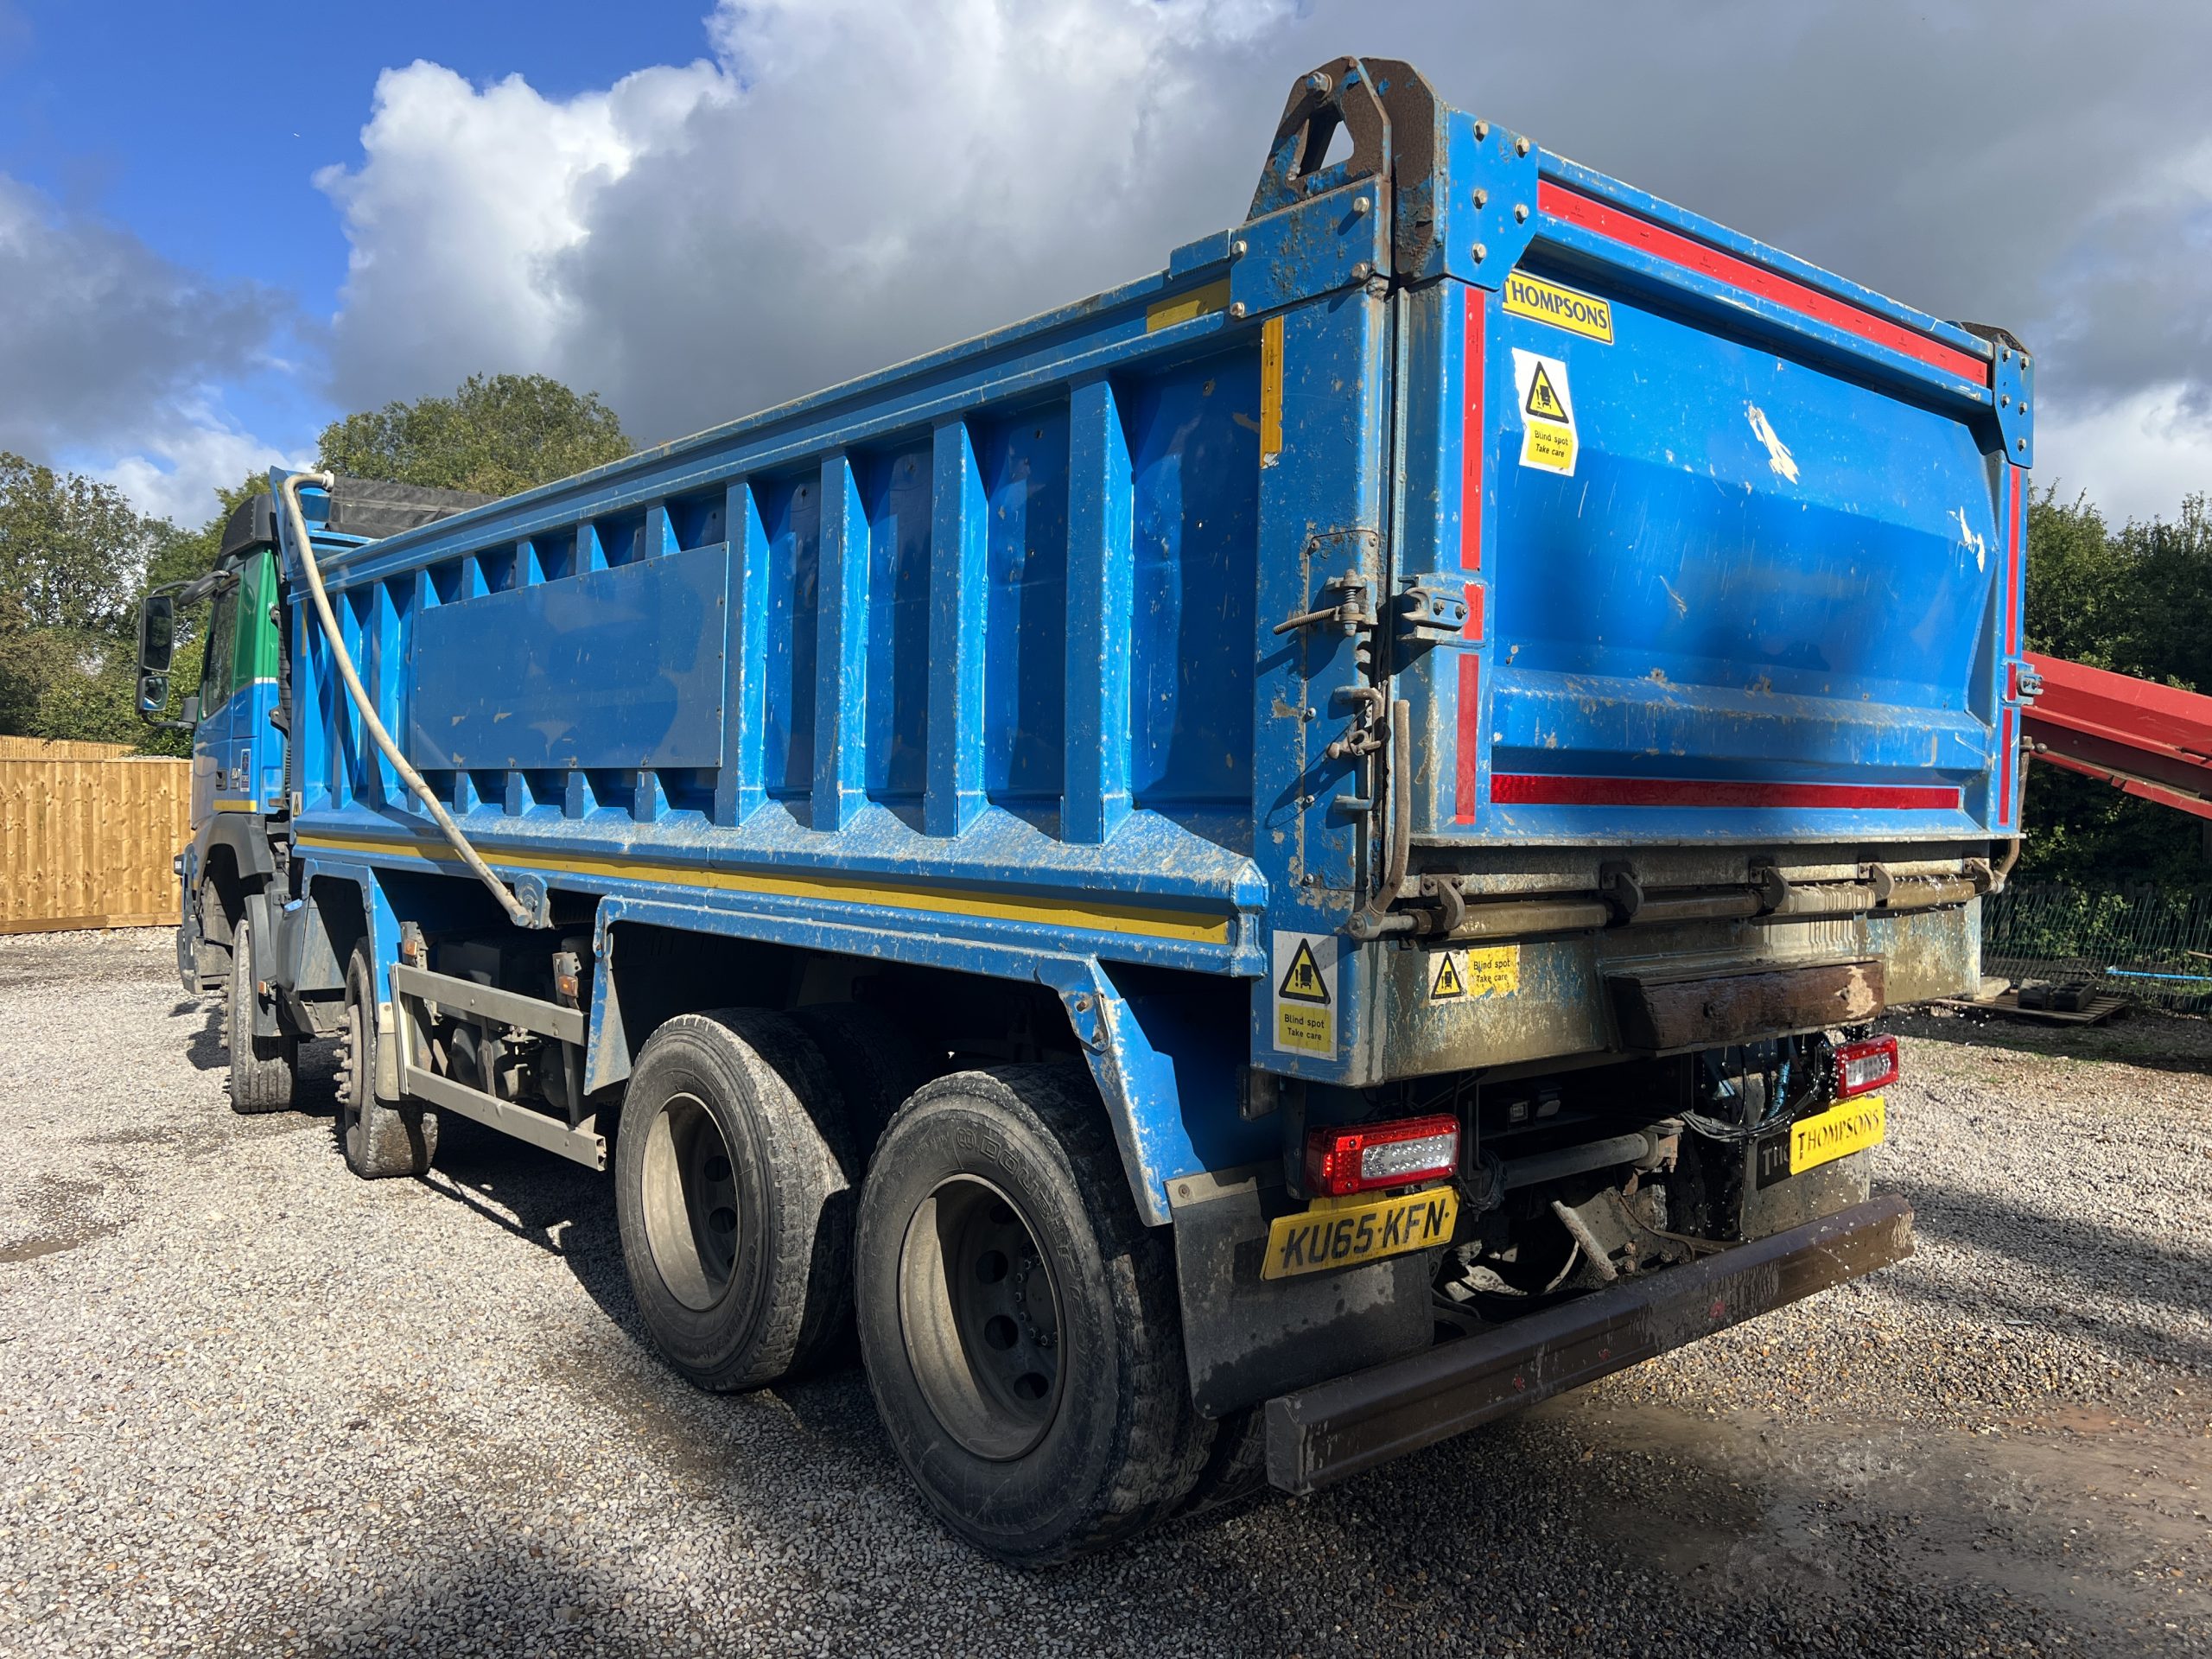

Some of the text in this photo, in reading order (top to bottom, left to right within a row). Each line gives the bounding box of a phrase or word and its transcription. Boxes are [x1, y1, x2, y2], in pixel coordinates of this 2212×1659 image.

[1535, 429, 1568, 446] Blind spot
[1535, 442, 1565, 458] Take care
[1474, 958, 1510, 970] Blind spot
[1476, 975, 1491, 983] Take
[1284, 1014, 1325, 1029] Blind spot
[1287, 1027, 1322, 1041] Take care
[1797, 1109, 1880, 1160] THOMPSONS
[1282, 1198, 1446, 1269] KU65 KFN
